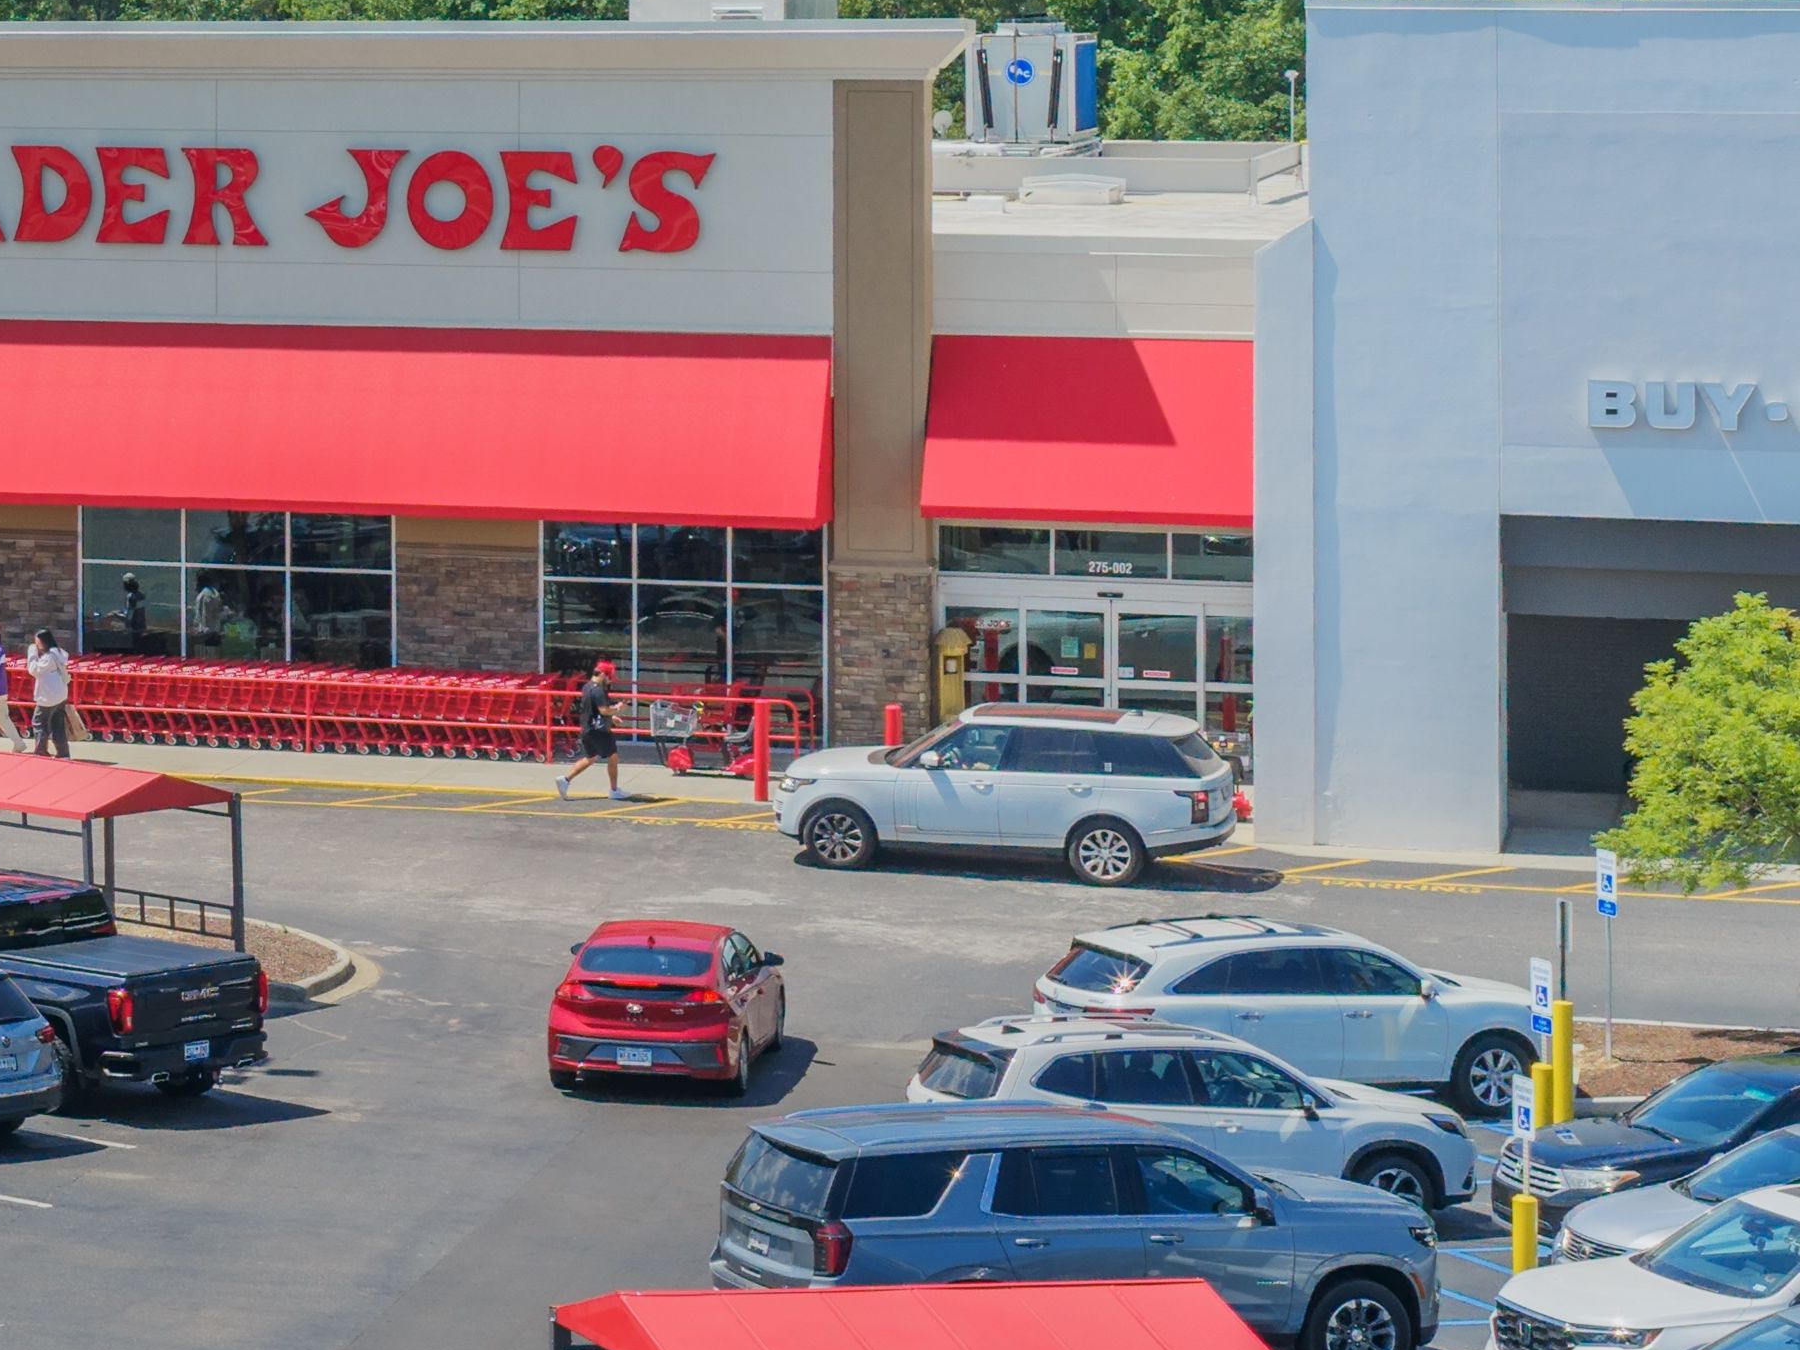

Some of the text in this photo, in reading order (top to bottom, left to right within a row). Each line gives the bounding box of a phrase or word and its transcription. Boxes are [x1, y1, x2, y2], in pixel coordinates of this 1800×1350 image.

[305, 146, 716, 252] JOE'S
[1088, 561, 1133, 575] 275-002
[1320, 878, 1484, 894] PARKING
